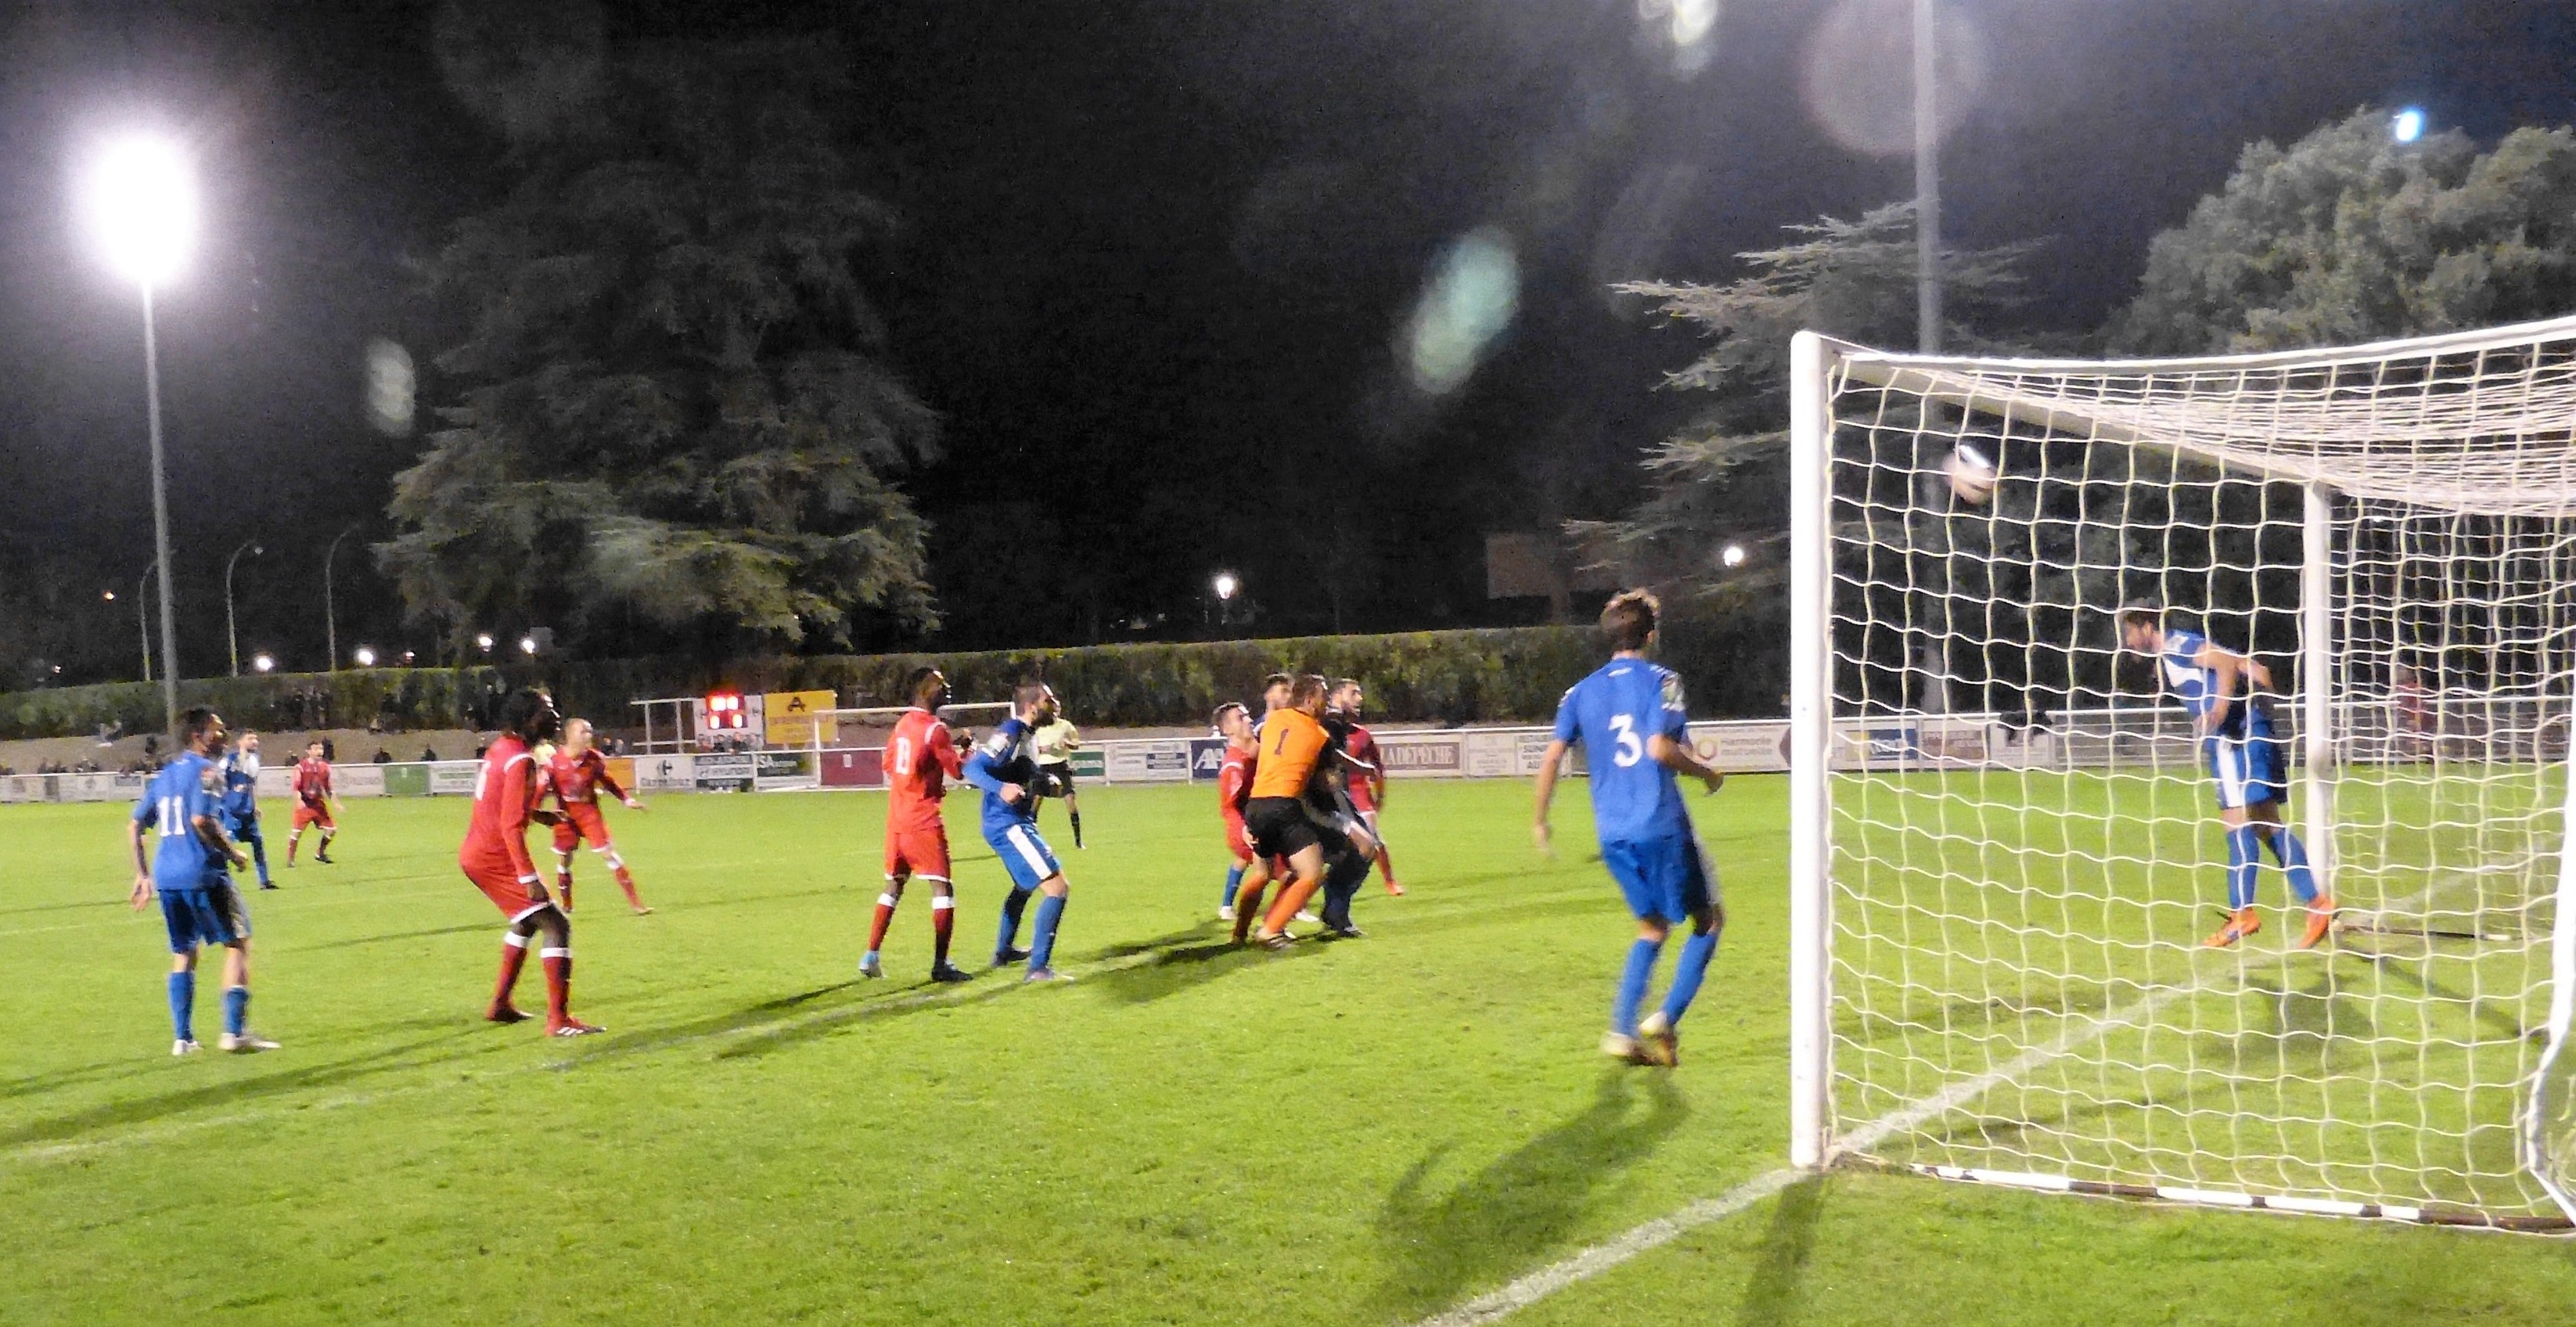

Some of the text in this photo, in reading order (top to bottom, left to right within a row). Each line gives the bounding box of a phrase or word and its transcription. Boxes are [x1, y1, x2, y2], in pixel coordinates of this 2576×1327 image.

[1274, 728, 1289, 756] 1
[1608, 714, 1642, 768] 3
[158, 797, 185, 836] 11
